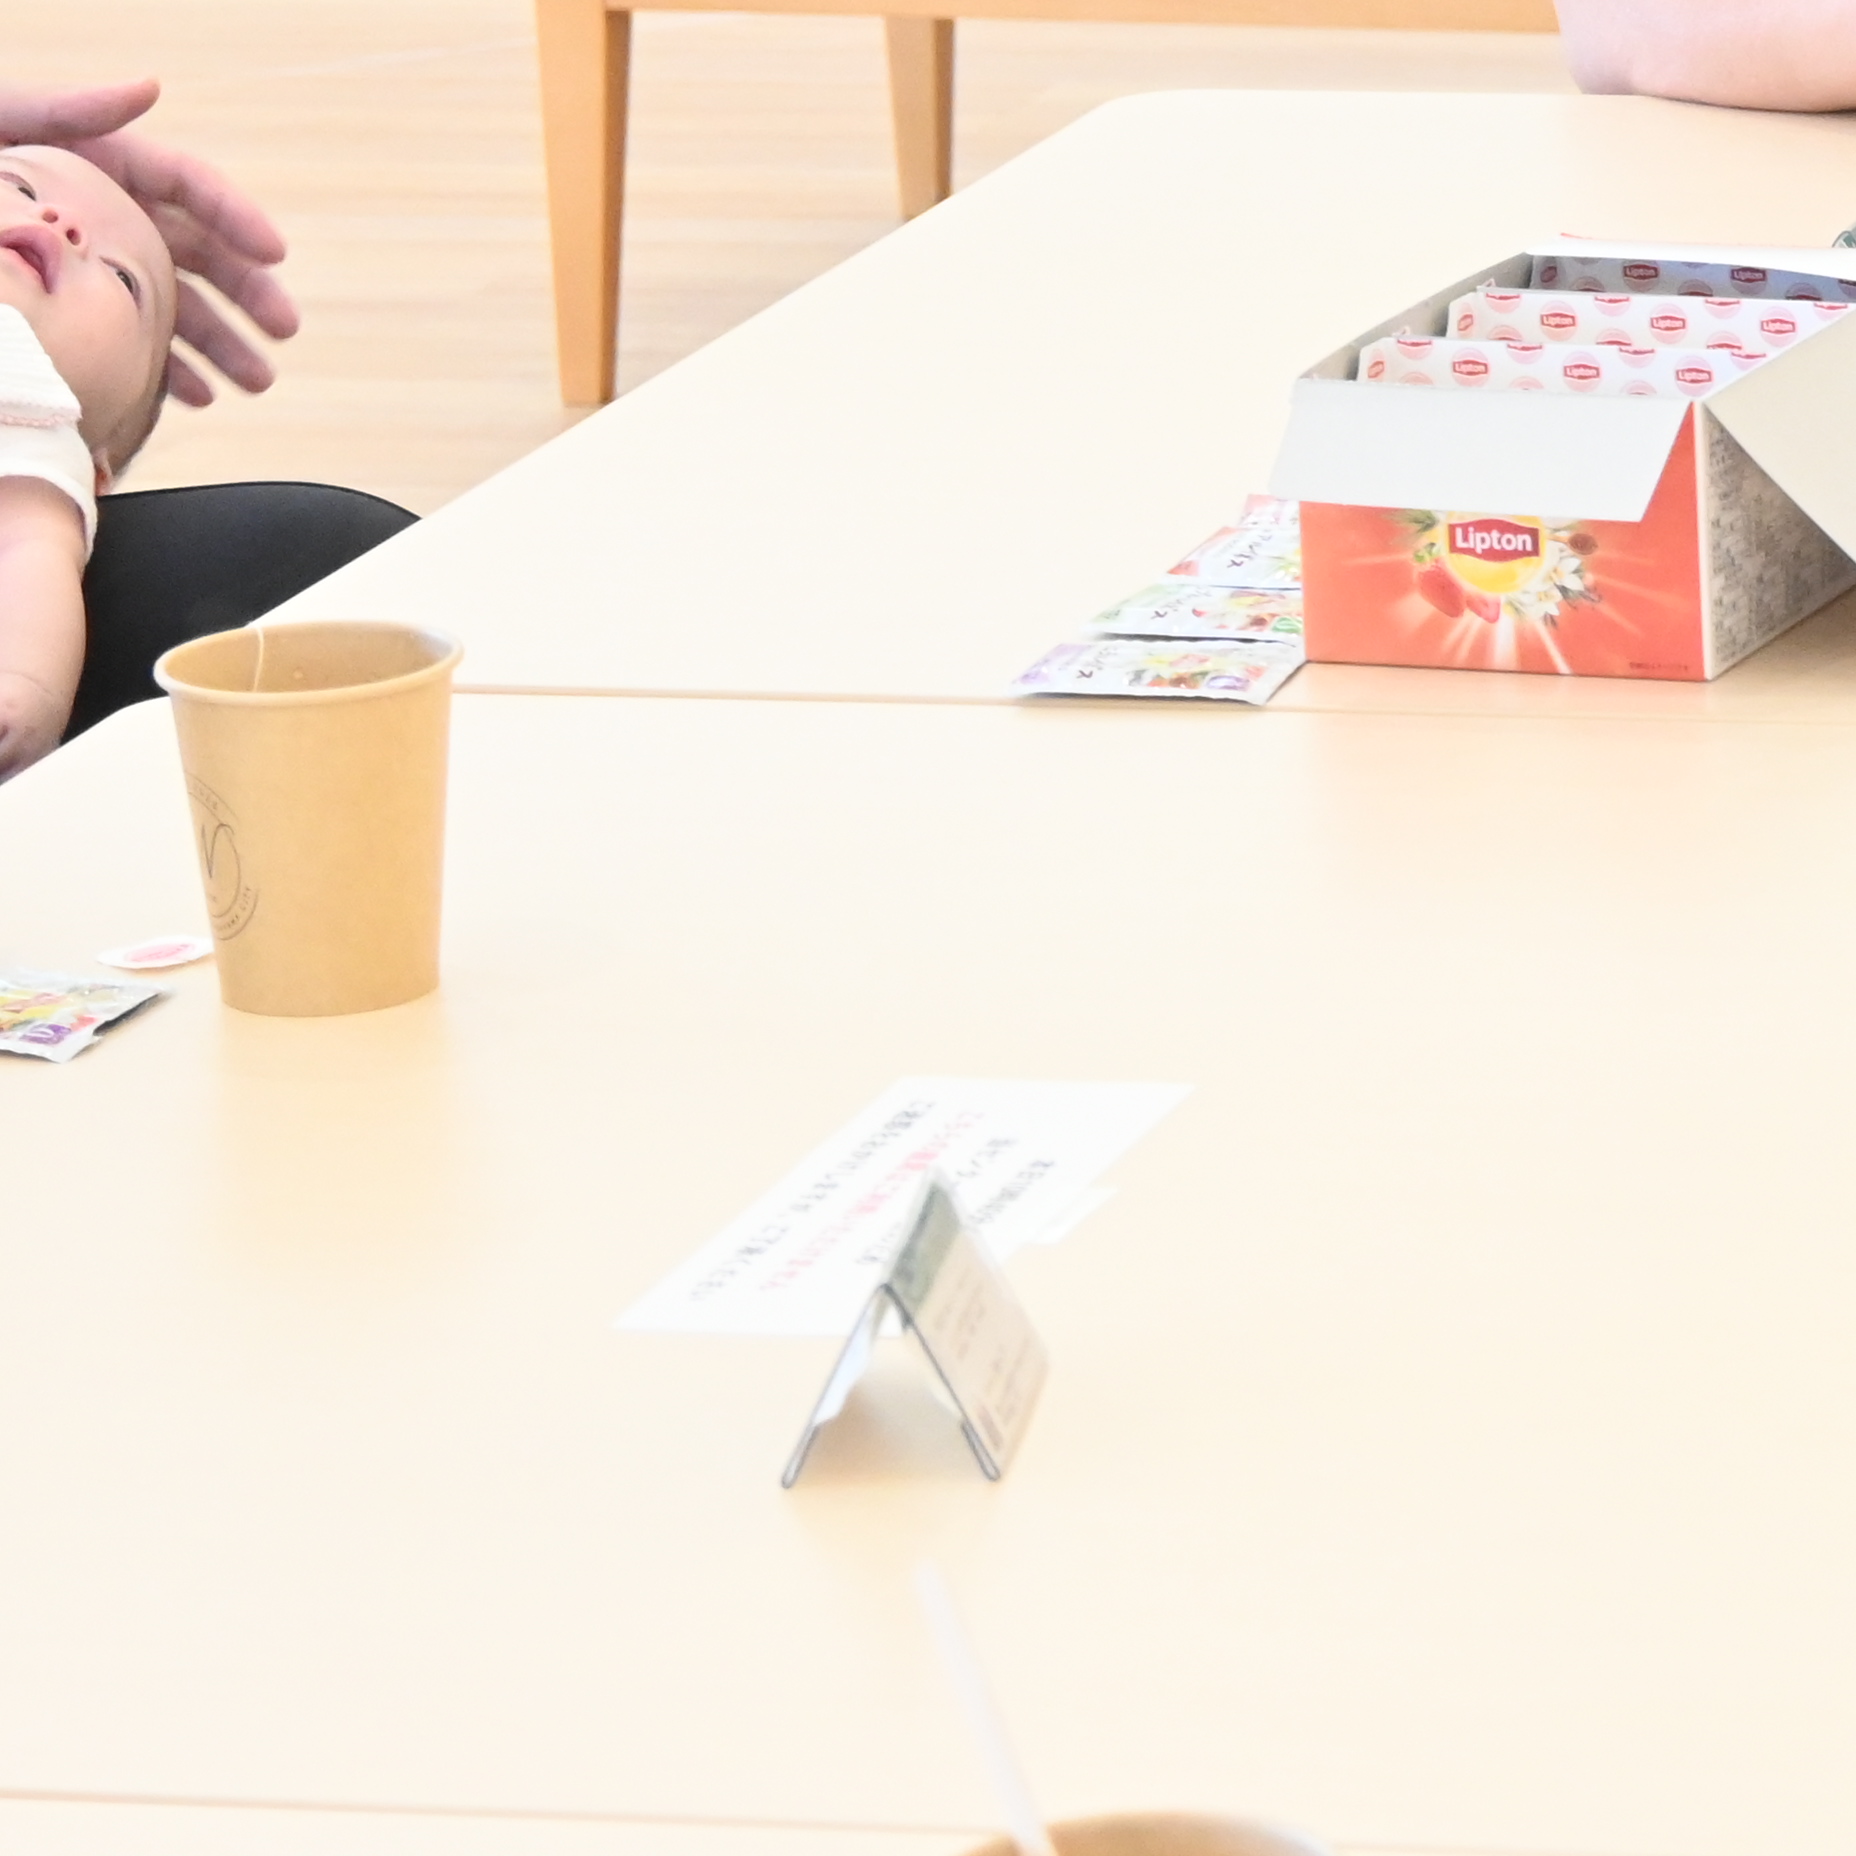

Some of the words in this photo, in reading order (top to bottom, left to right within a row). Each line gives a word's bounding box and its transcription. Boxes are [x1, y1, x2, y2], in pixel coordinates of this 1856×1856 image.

[1541, 316, 1574, 327] Lipton
[1653, 318, 1685, 329] Lipton
[1763, 321, 1794, 332] Lipton
[1455, 363, 1487, 374] Lipton
[1566, 367, 1598, 378] Lipton
[1678, 370, 1710, 381] Lipton
[1455, 526, 1533, 554] Lipton
